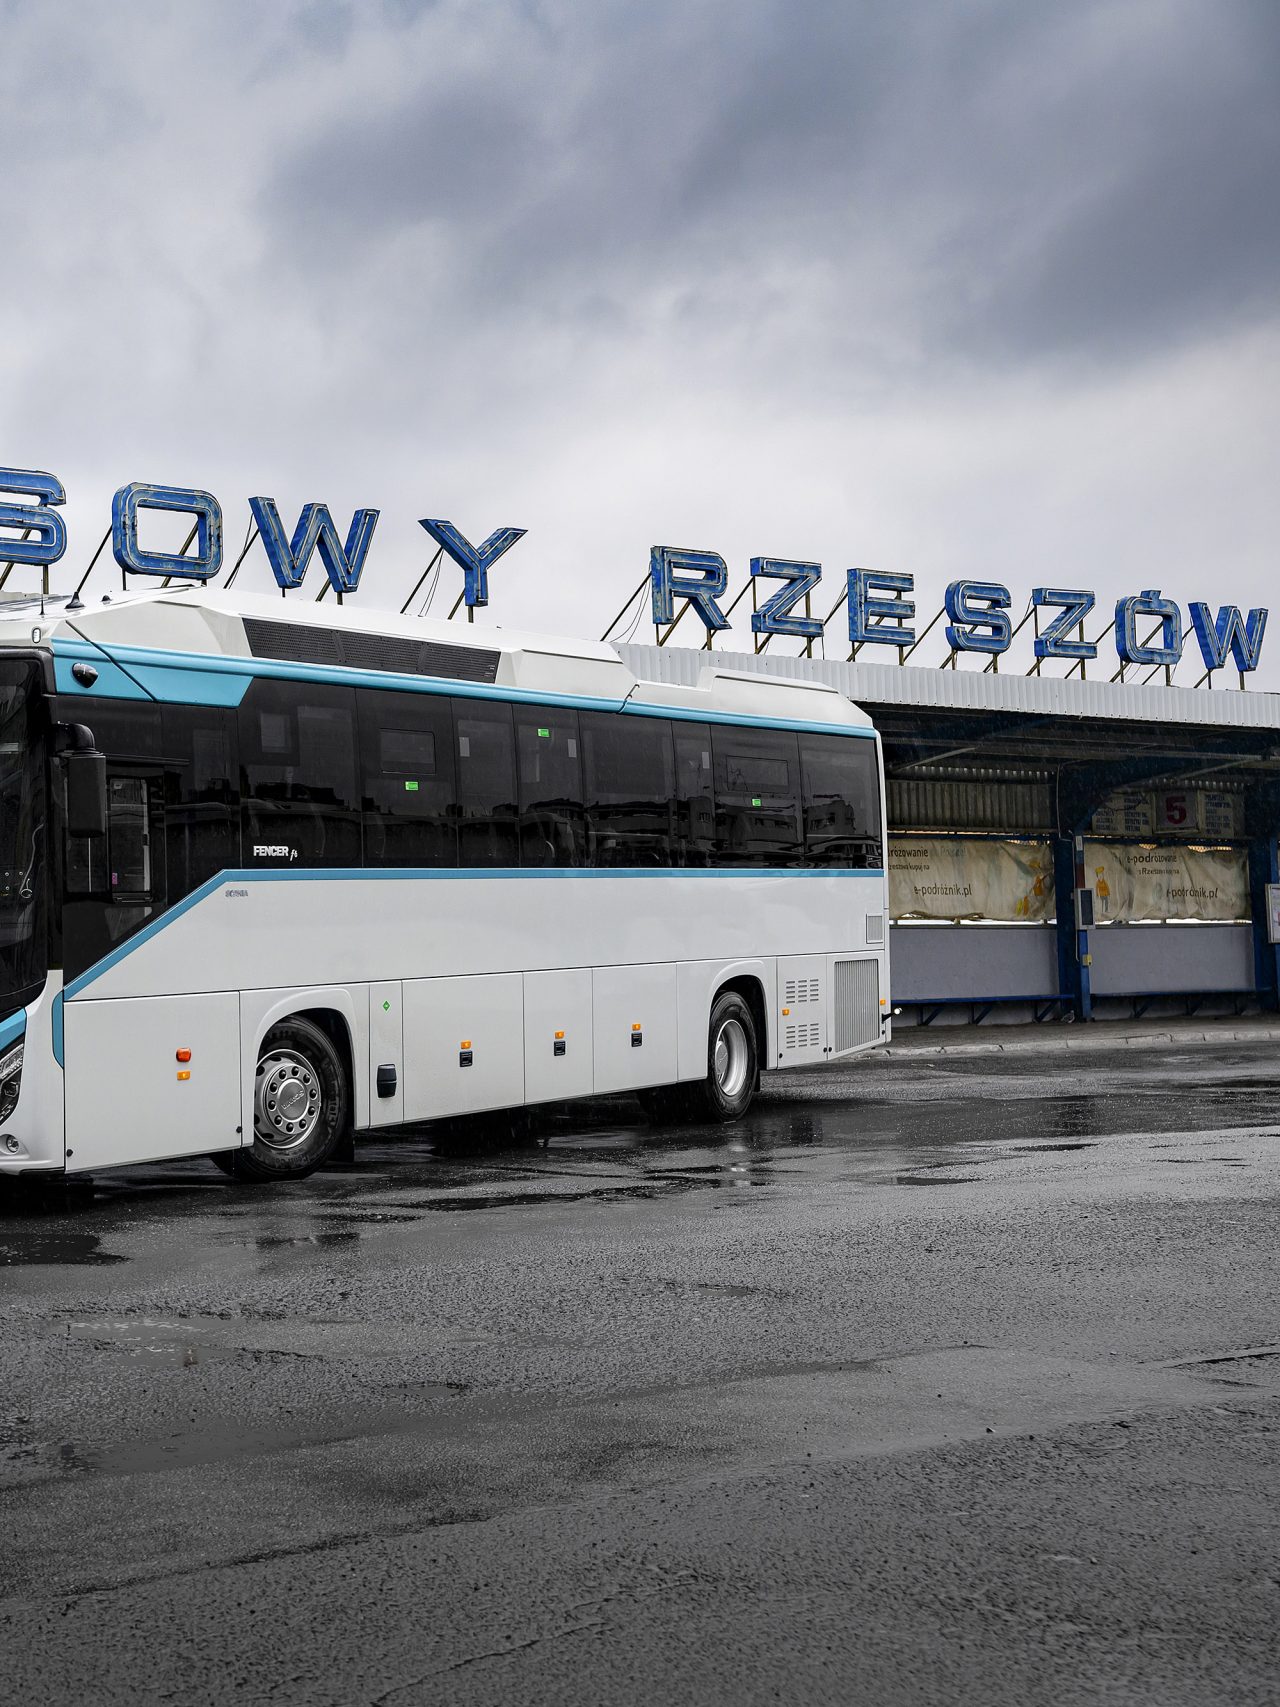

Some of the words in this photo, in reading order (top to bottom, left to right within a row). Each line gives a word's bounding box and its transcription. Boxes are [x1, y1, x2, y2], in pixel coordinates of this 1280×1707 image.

[650, 545, 1270, 673] RZESZÓW
[1165, 795, 1187, 825] 5
[253, 845, 289, 857] FENCER
